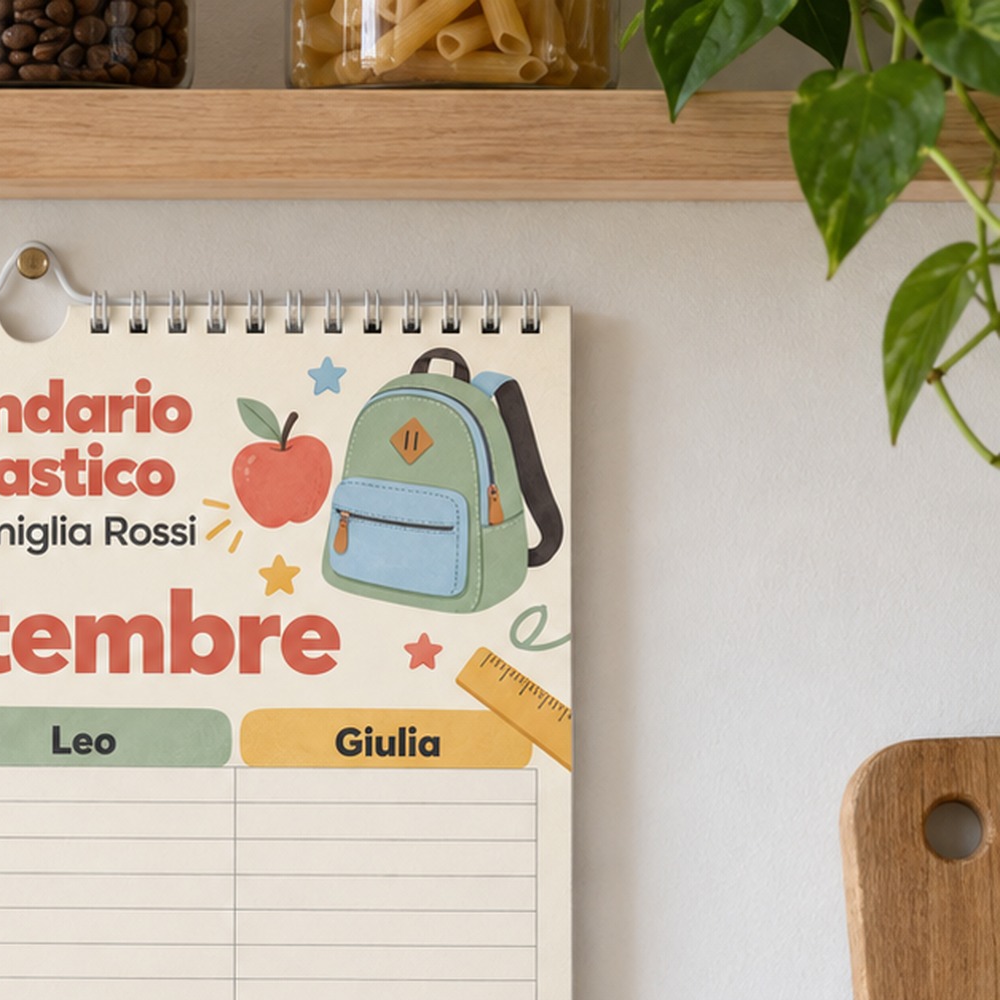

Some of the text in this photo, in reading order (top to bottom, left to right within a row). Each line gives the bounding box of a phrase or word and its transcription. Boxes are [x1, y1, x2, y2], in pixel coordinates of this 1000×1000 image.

[105, 515, 196, 546] Rossi
[52, 725, 117, 755] Leo
[335, 725, 441, 758] Giulia
